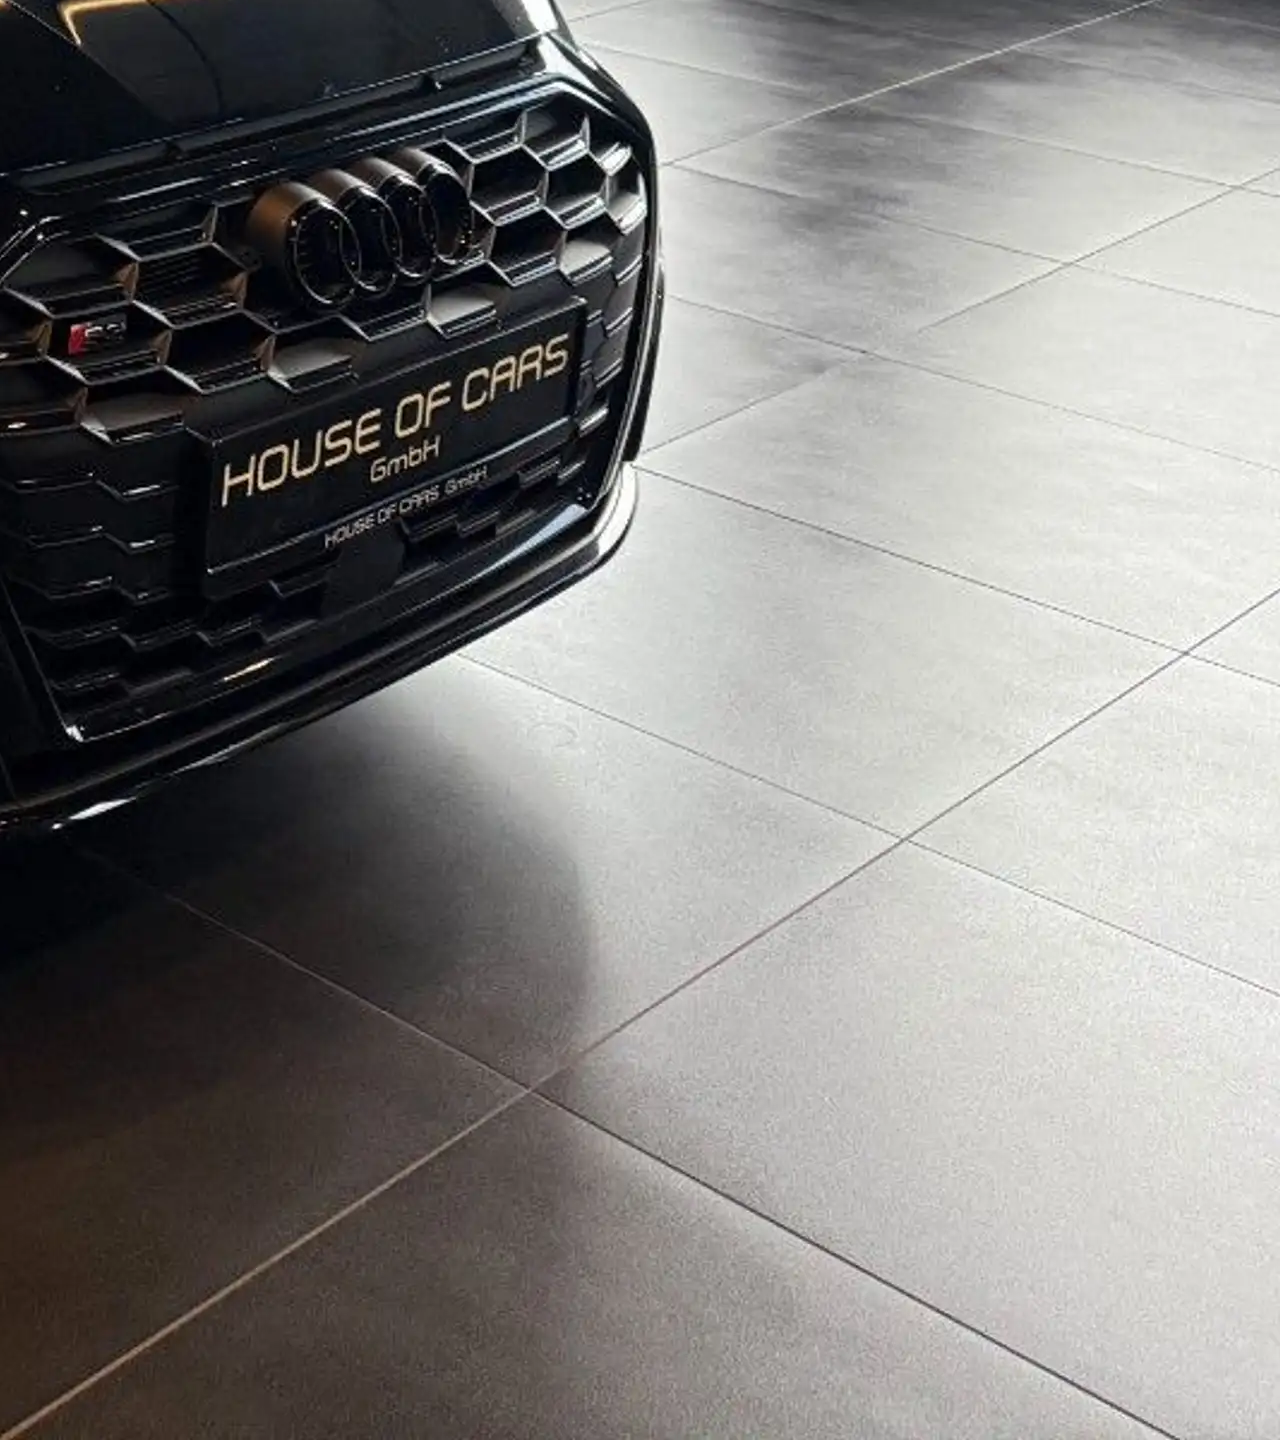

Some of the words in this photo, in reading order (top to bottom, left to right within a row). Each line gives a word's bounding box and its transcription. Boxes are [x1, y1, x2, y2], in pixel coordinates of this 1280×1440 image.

[221, 408, 382, 507] HOUSE
[394, 381, 452, 440] OF
[461, 333, 569, 412] CARS
[370, 436, 441, 483] GmbH
[324, 513, 376, 550] HOUSE
[377, 502, 398, 525] OF
[398, 484, 441, 515] CARS
[444, 465, 489, 496] GmbH
